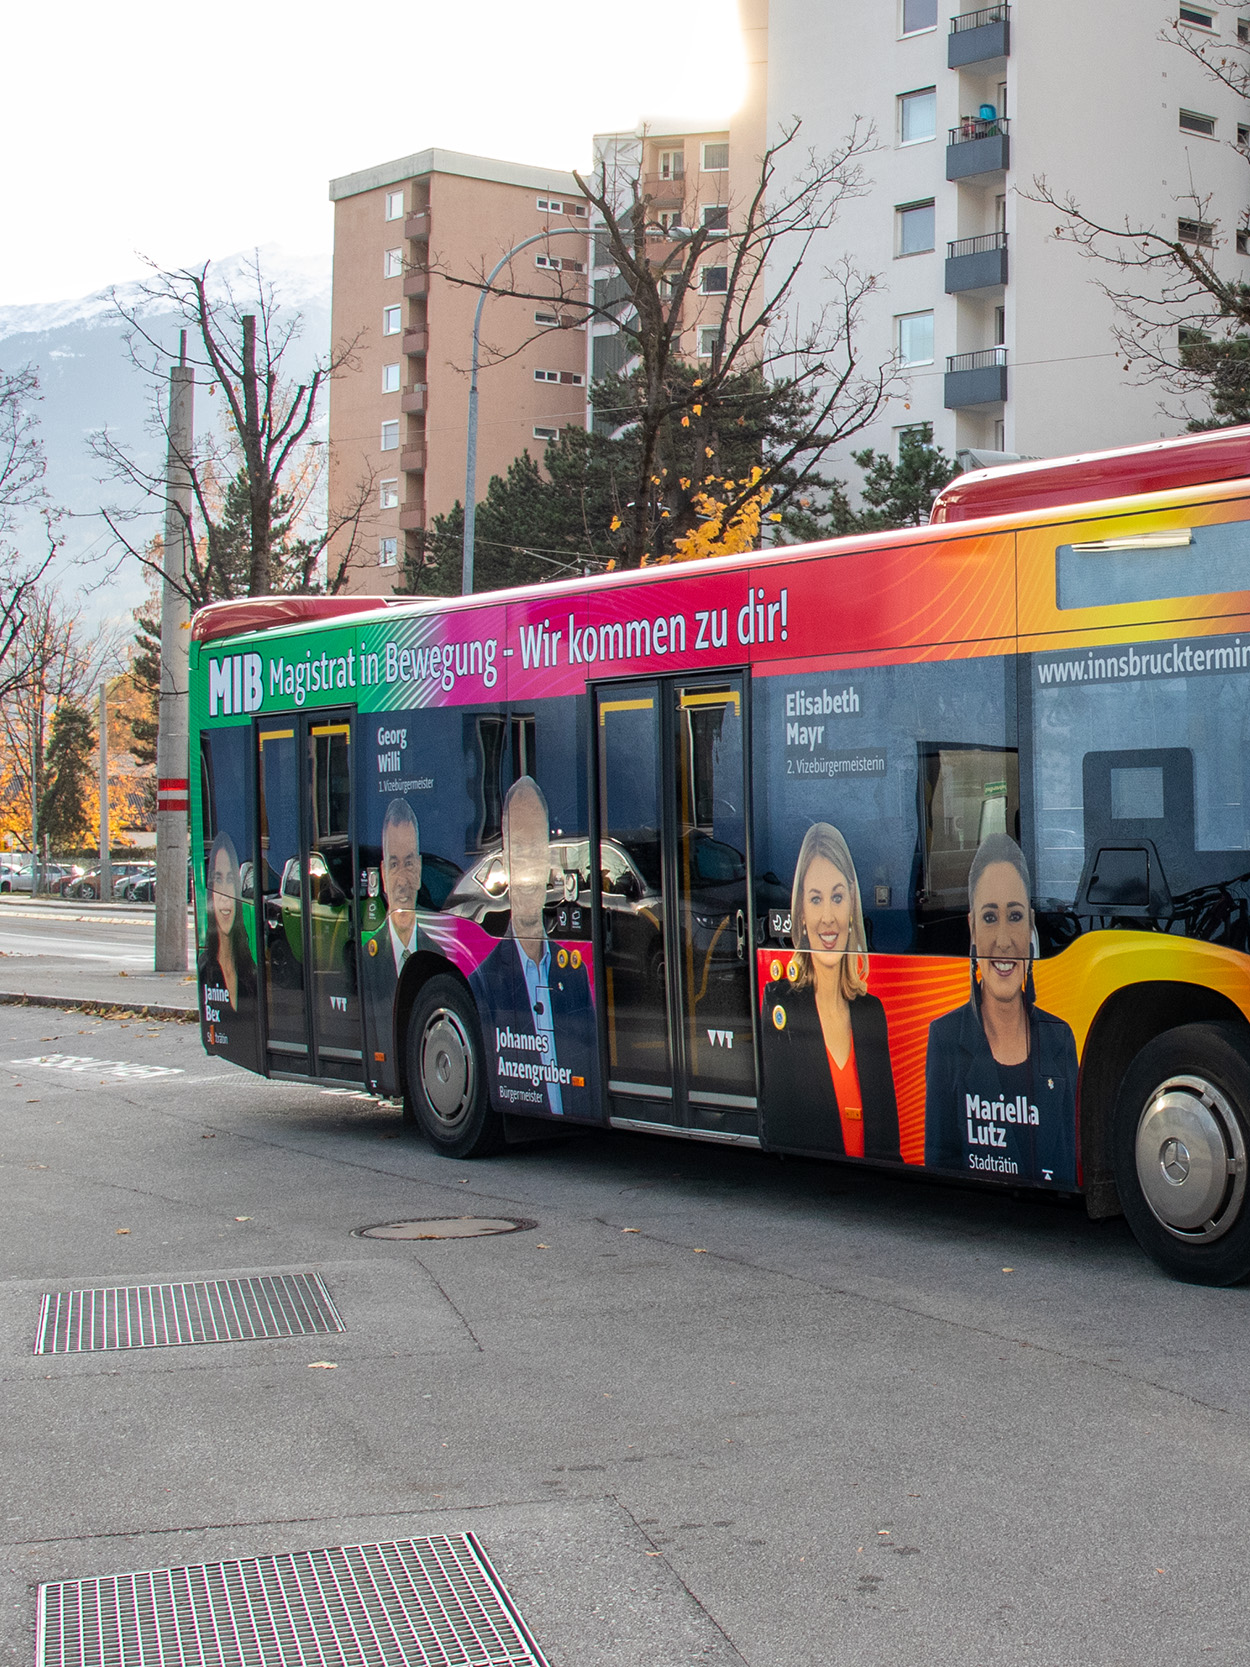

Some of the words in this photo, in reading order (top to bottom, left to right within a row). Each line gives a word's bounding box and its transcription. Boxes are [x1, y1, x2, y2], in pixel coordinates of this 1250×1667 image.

[209, 652, 263, 717] MIB
[270, 648, 356, 705] Magistrat
[360, 642, 379, 686] in
[385, 639, 498, 692] Bewegung
[519, 618, 562, 669] Wir
[568, 613, 686, 665] kommen
[695, 608, 728, 650] zu
[737, 588, 788, 646] dir!
[786, 686, 860, 716] Elisabeth
[377, 727, 408, 749] Georg
[786, 722, 825, 752] Mayr
[377, 750, 401, 773] Willi
[787, 760, 795, 774] 2.
[796, 755, 885, 778] Vizebürgermeisterin
[204, 983, 230, 1005] Janine
[205, 1005, 221, 1023] Bex
[495, 1026, 549, 1053] Johannes
[498, 1056, 572, 1087] Anzengruber
[499, 1085, 543, 1103] Bürgermeister
[965, 1093, 1040, 1126] Mariella
[967, 1119, 1007, 1148] Lutz
[968, 1153, 1019, 1175] Stadträtin
